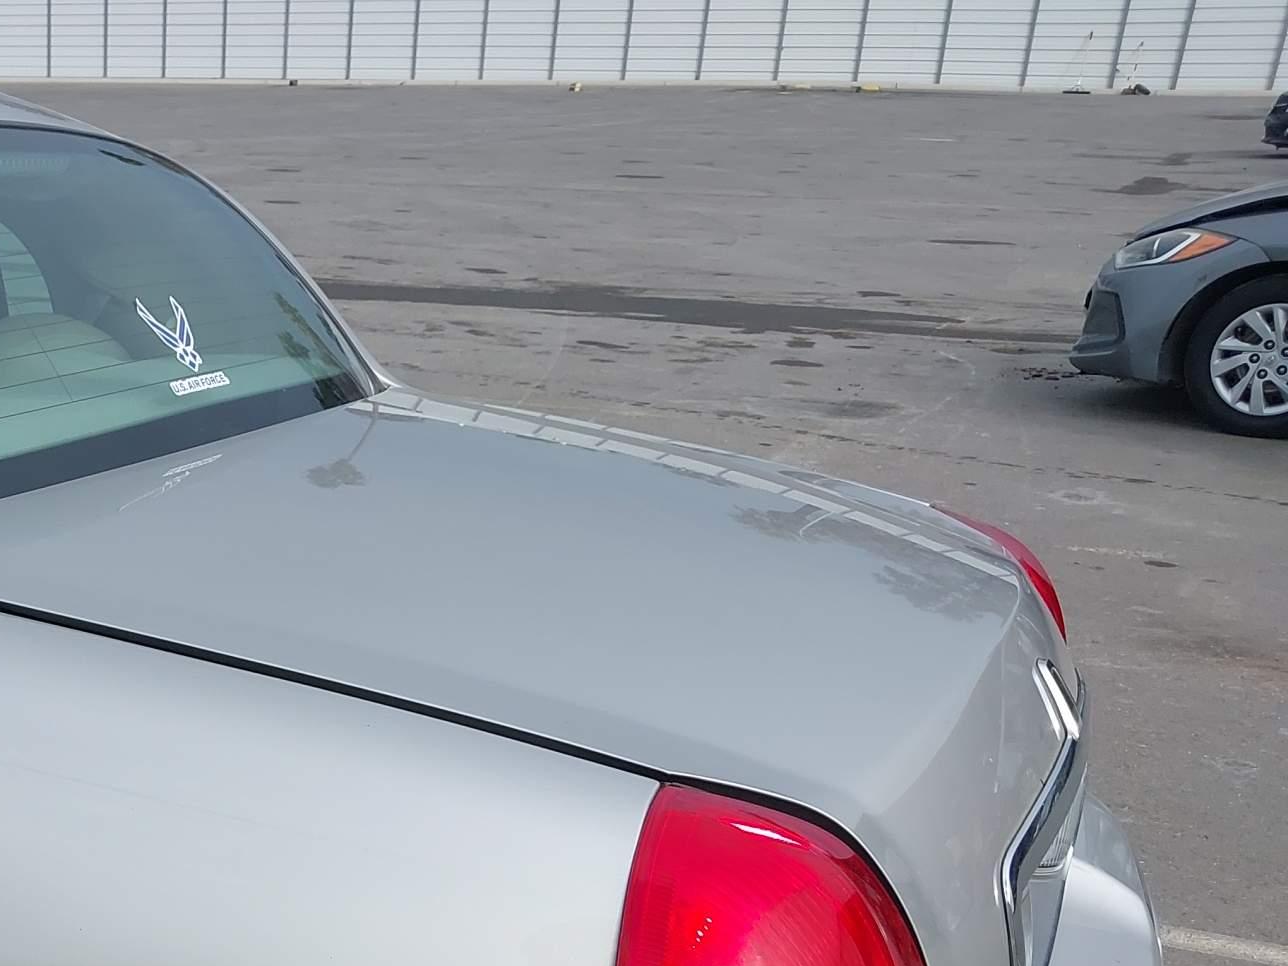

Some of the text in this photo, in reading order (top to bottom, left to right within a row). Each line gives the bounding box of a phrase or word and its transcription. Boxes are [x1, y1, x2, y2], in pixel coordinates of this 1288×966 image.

[173, 374, 227, 393] U.S. AIR FORCE
